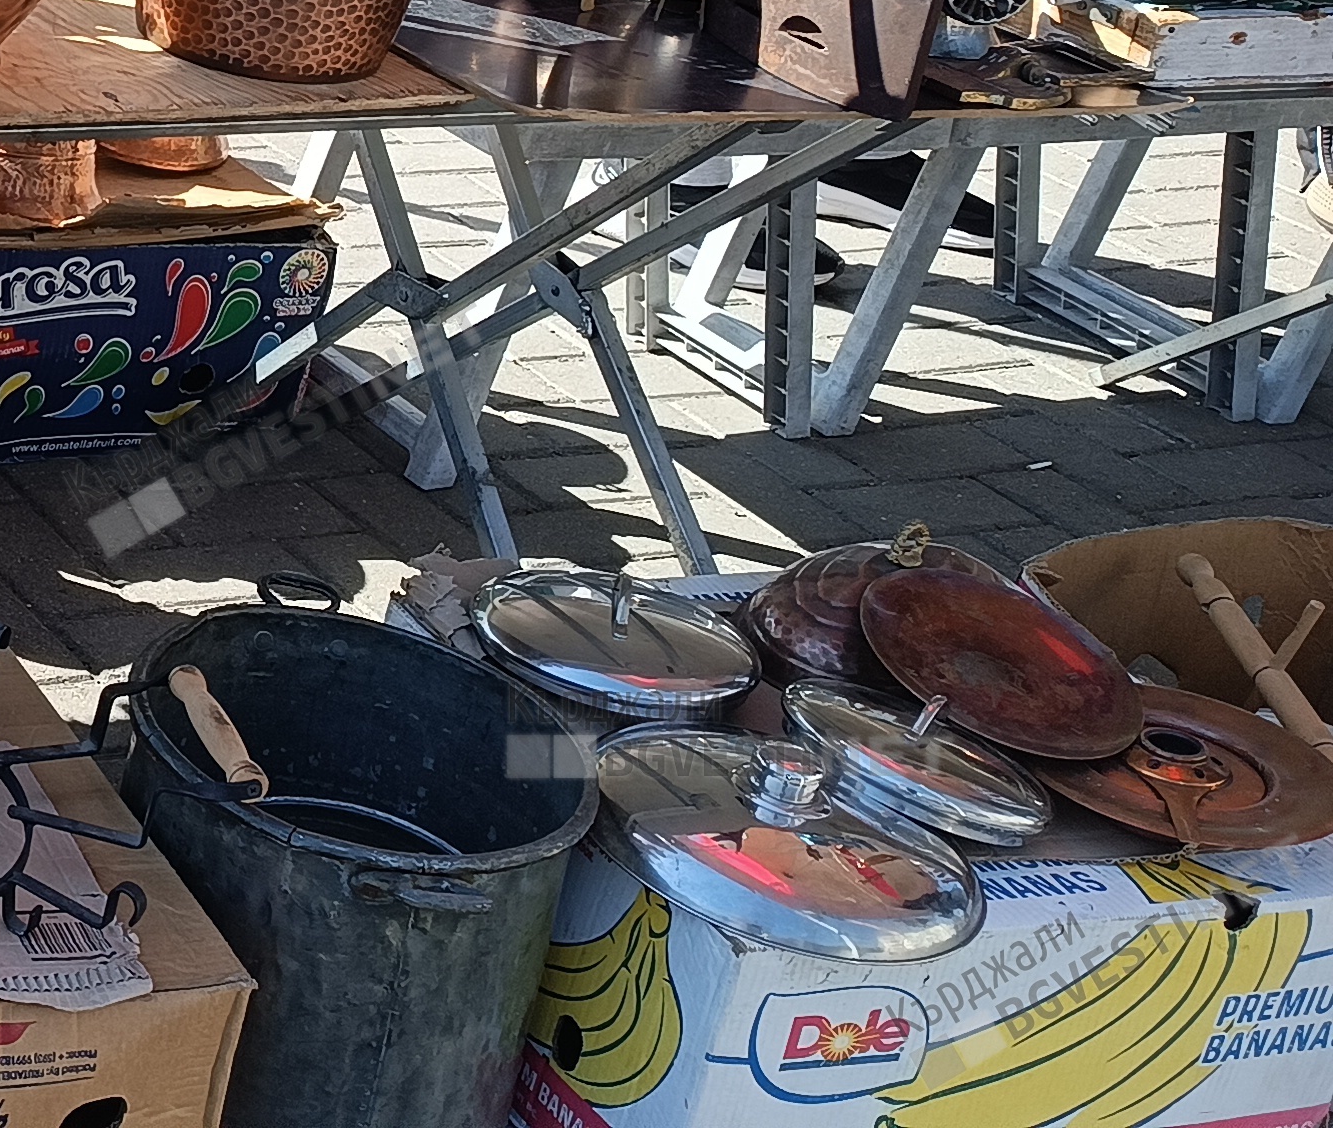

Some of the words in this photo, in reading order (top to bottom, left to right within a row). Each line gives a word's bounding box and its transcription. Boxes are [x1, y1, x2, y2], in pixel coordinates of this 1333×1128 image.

[12, 437, 141, 454] www.donatellafruit.com
[783, 1009, 911, 1061] Dole
[1201, 1021, 1333, 1064] BANANA
